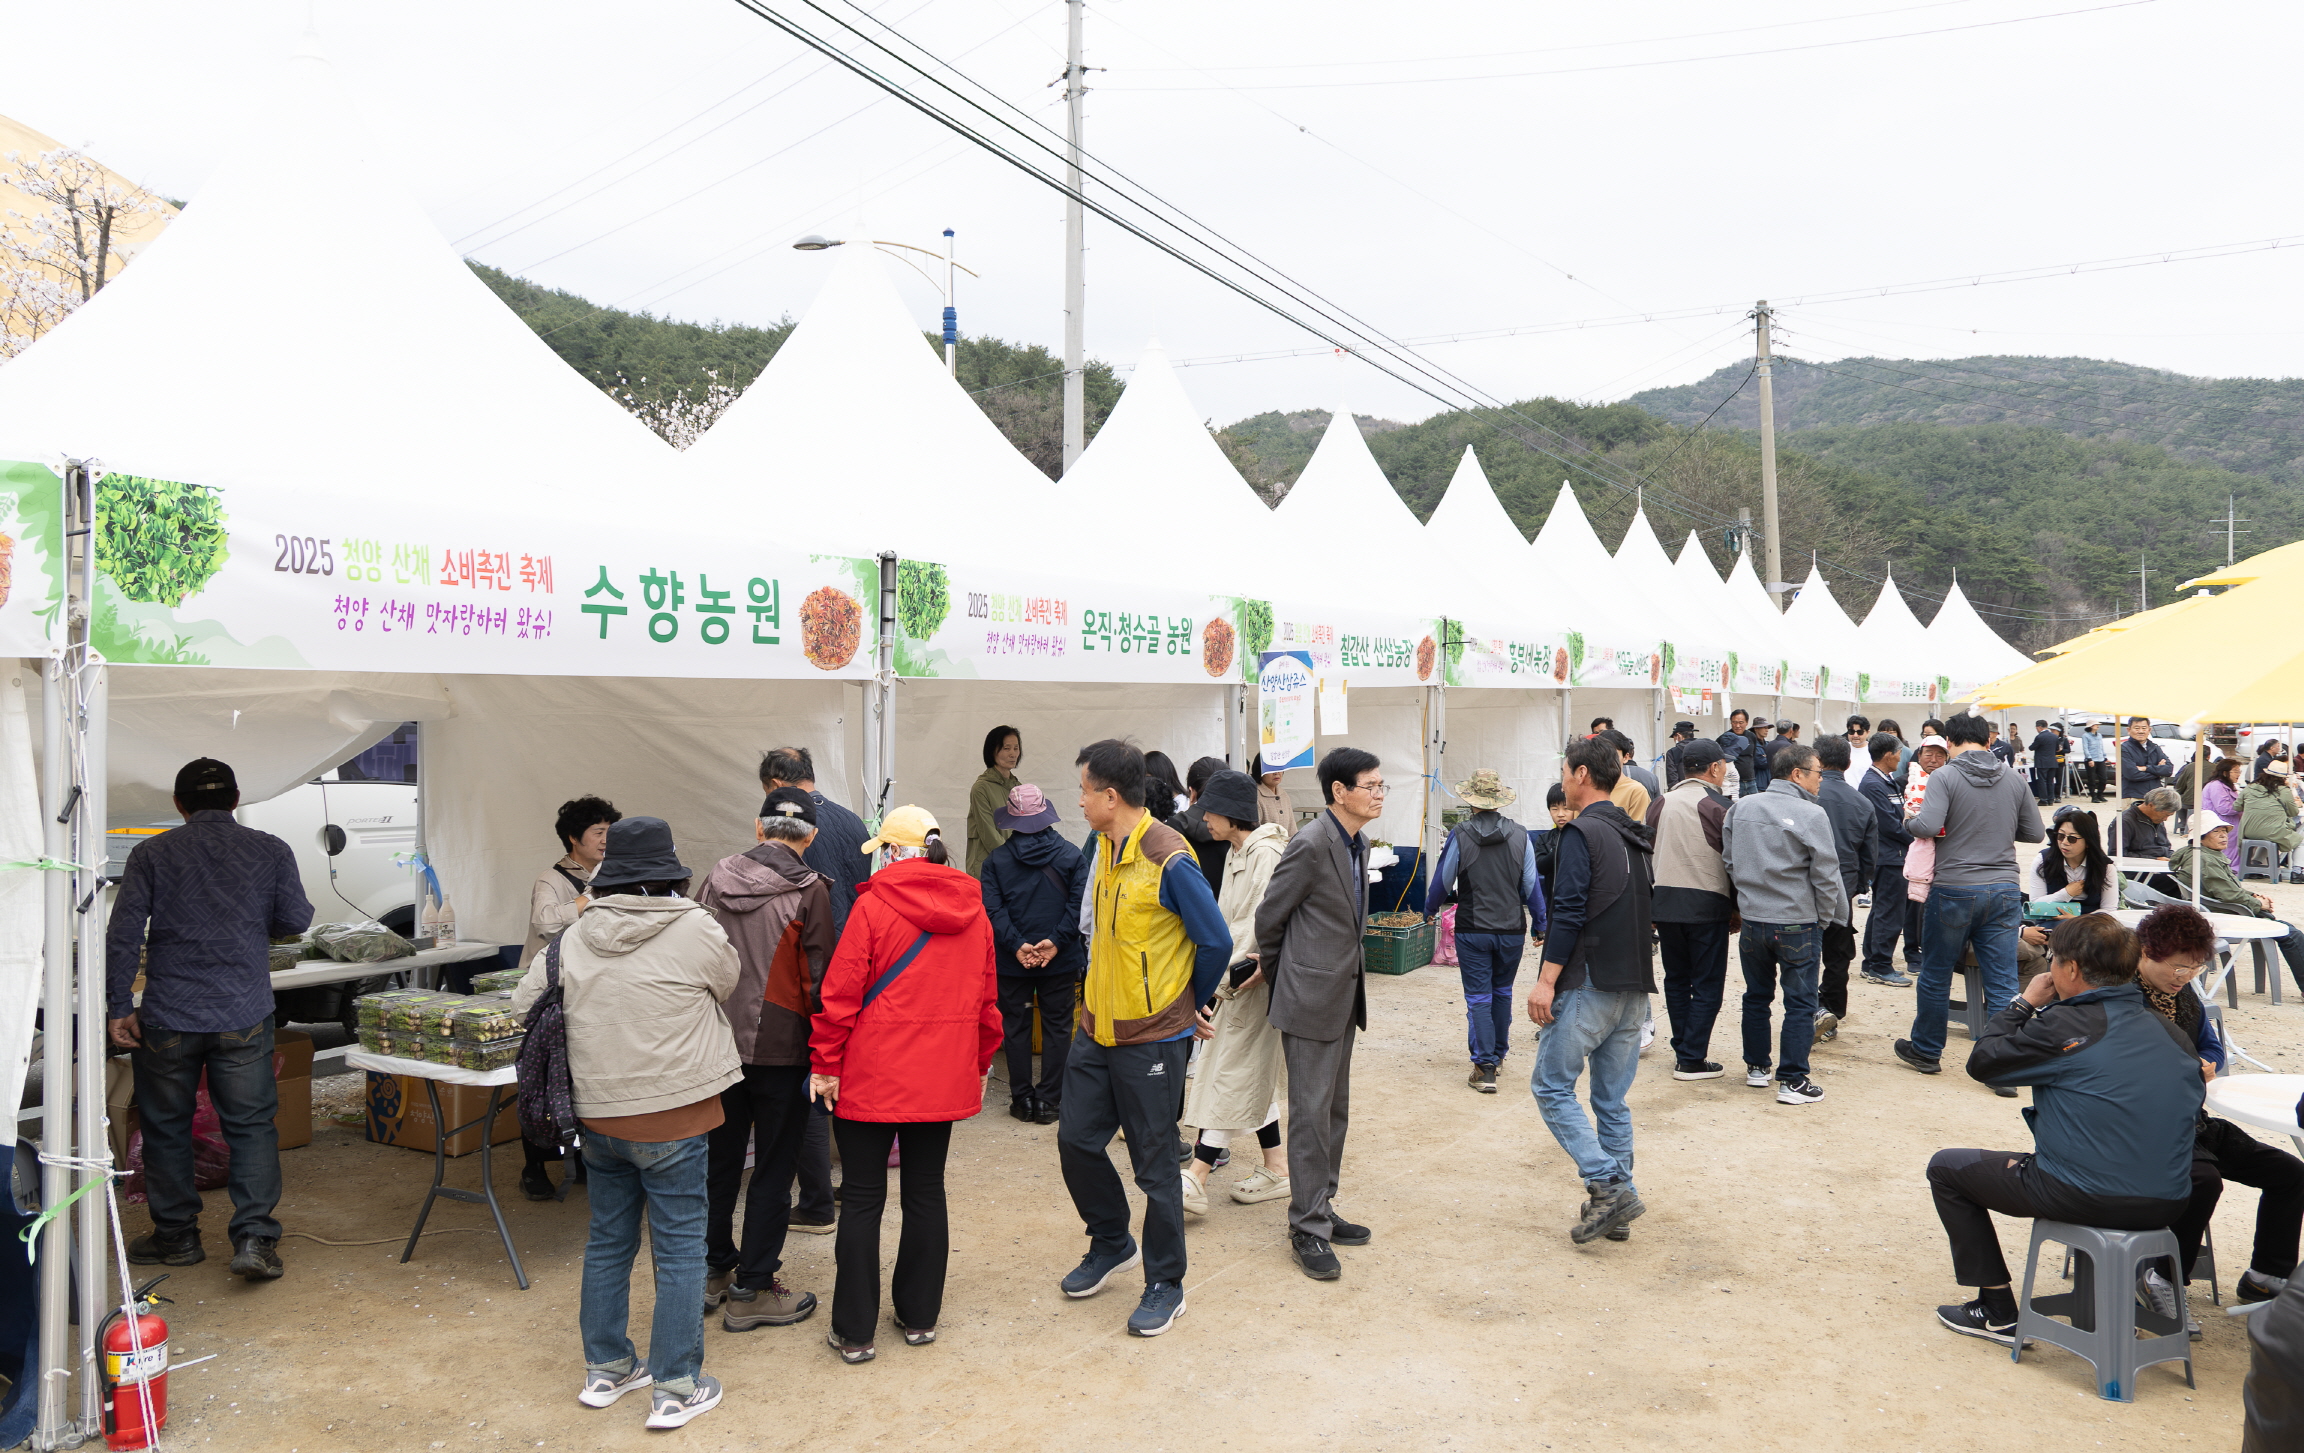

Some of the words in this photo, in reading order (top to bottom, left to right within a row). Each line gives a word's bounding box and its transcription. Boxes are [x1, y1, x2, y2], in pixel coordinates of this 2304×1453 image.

[274, 534, 334, 576] 2025
[342, 537, 382, 583] 청양
[391, 542, 431, 586] 산채
[440, 548, 512, 591] 소비촉진
[519, 553, 553, 594] 축제
[334, 594, 370, 631] 청양
[380, 599, 415, 632] 산채
[426, 602, 507, 636] 맛자랑하러
[516, 607, 552, 640] 왔슈!
[581, 565, 780, 645] 수향농원
[967, 591, 988, 619] 2025
[1024, 596, 1052, 625] 소비촉진
[1054, 597, 1068, 627] 축제
[986, 630, 1000, 654] 청양
[1002, 631, 1016, 656] 산채
[1166, 617, 1193, 655] 농원
[1340, 634, 1371, 667] 칠갑산
[1373, 636, 1414, 668] 산삼농장
